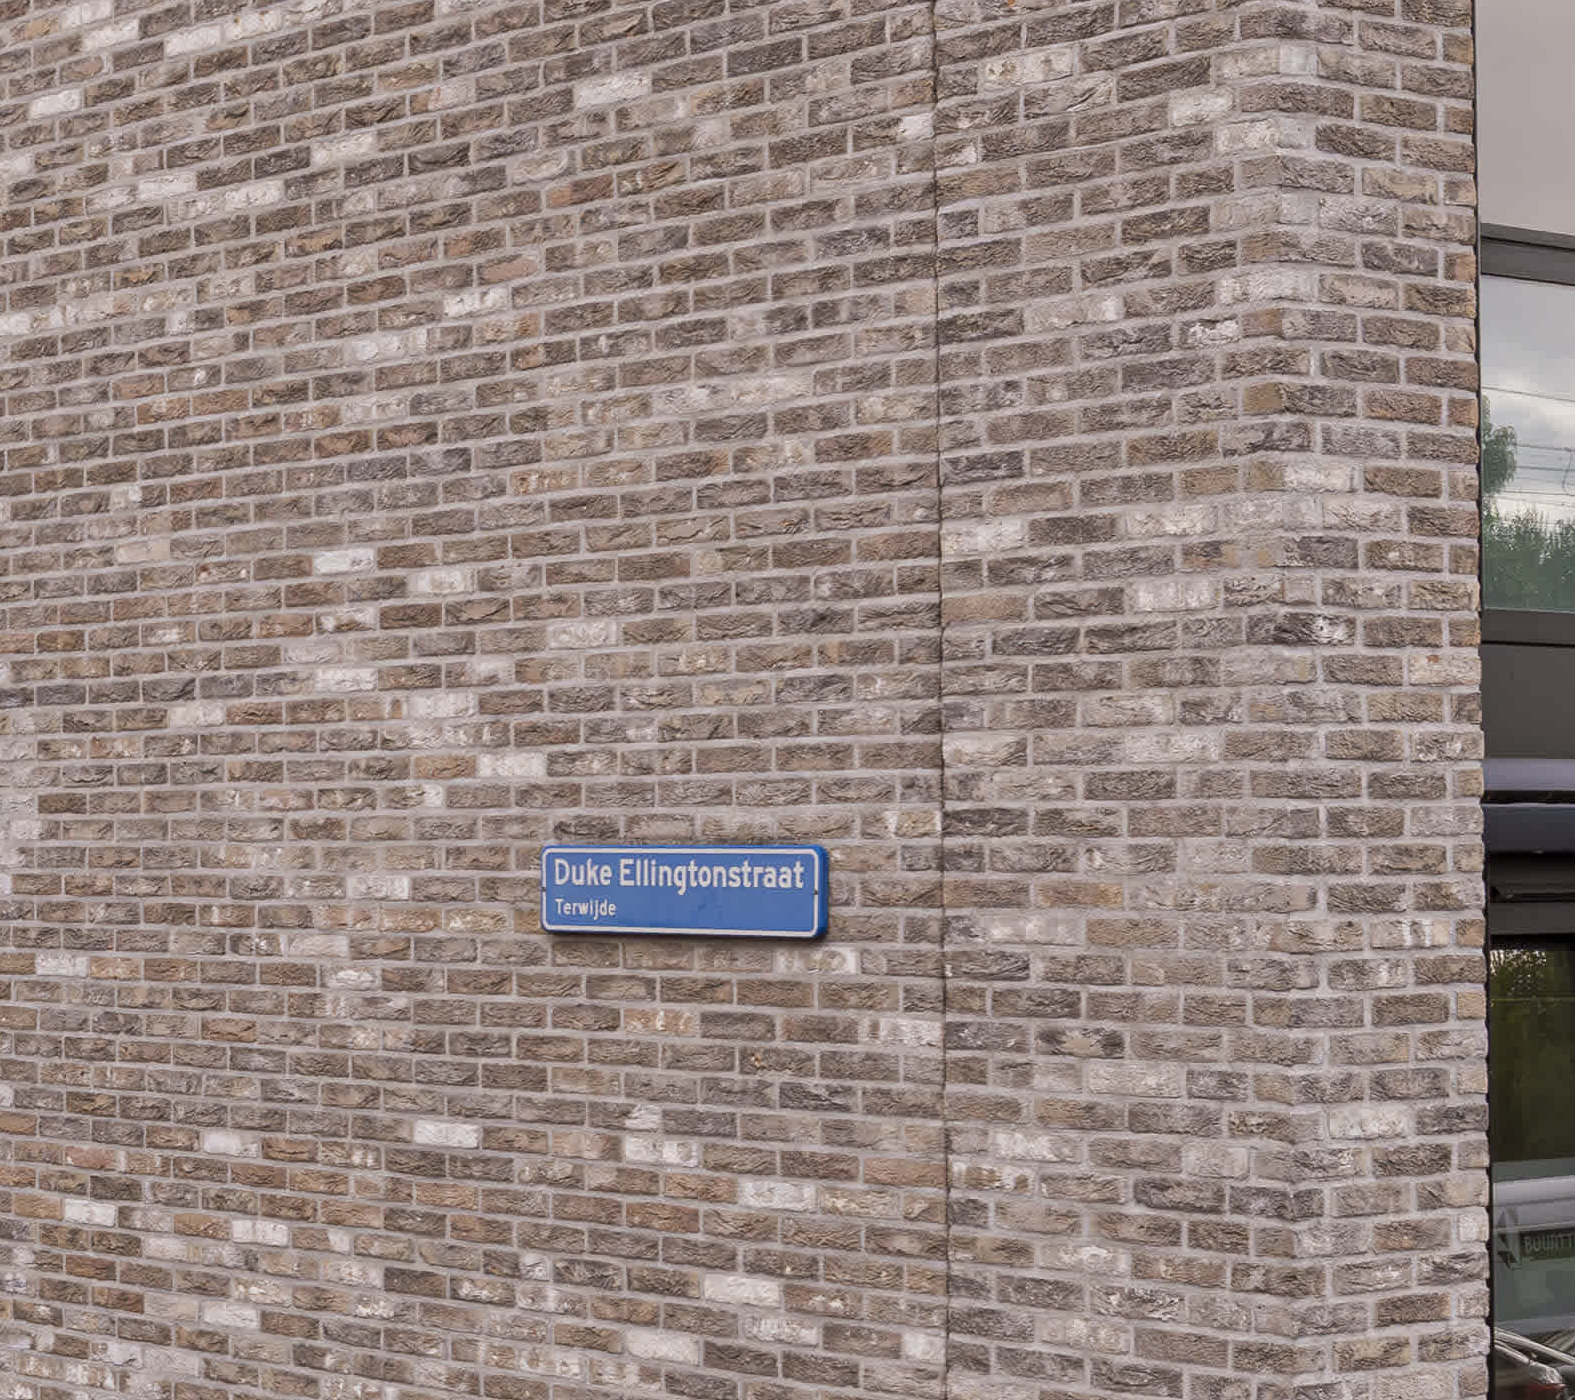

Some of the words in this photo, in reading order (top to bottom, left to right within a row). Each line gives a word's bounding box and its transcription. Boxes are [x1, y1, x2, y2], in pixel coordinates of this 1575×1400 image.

[554, 858, 613, 886] Duke
[619, 858, 805, 896] Ellingtonstraat
[554, 898, 617, 920] Terwijde
